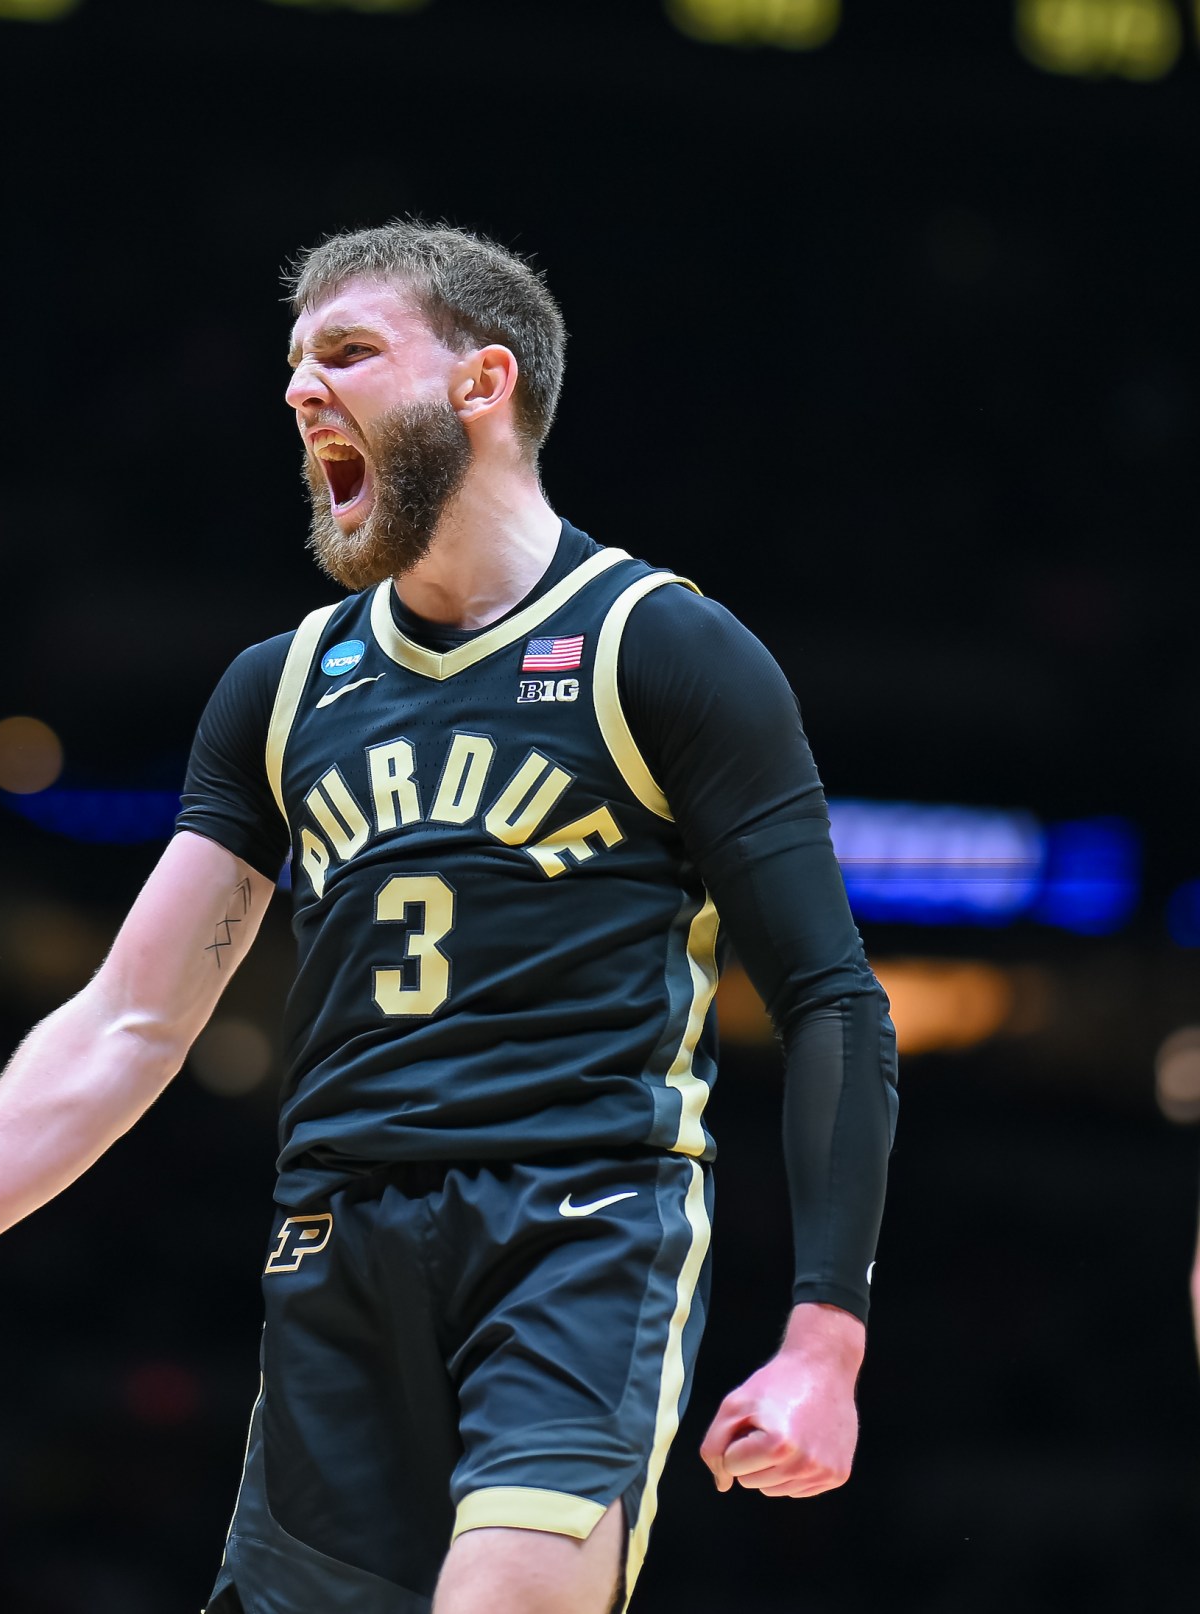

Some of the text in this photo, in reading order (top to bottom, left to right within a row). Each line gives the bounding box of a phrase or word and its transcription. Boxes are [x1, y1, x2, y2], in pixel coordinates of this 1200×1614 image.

[325, 654, 361, 668] NCAA
[300, 732, 626, 900] PURDUE
[373, 872, 456, 1018] 3
